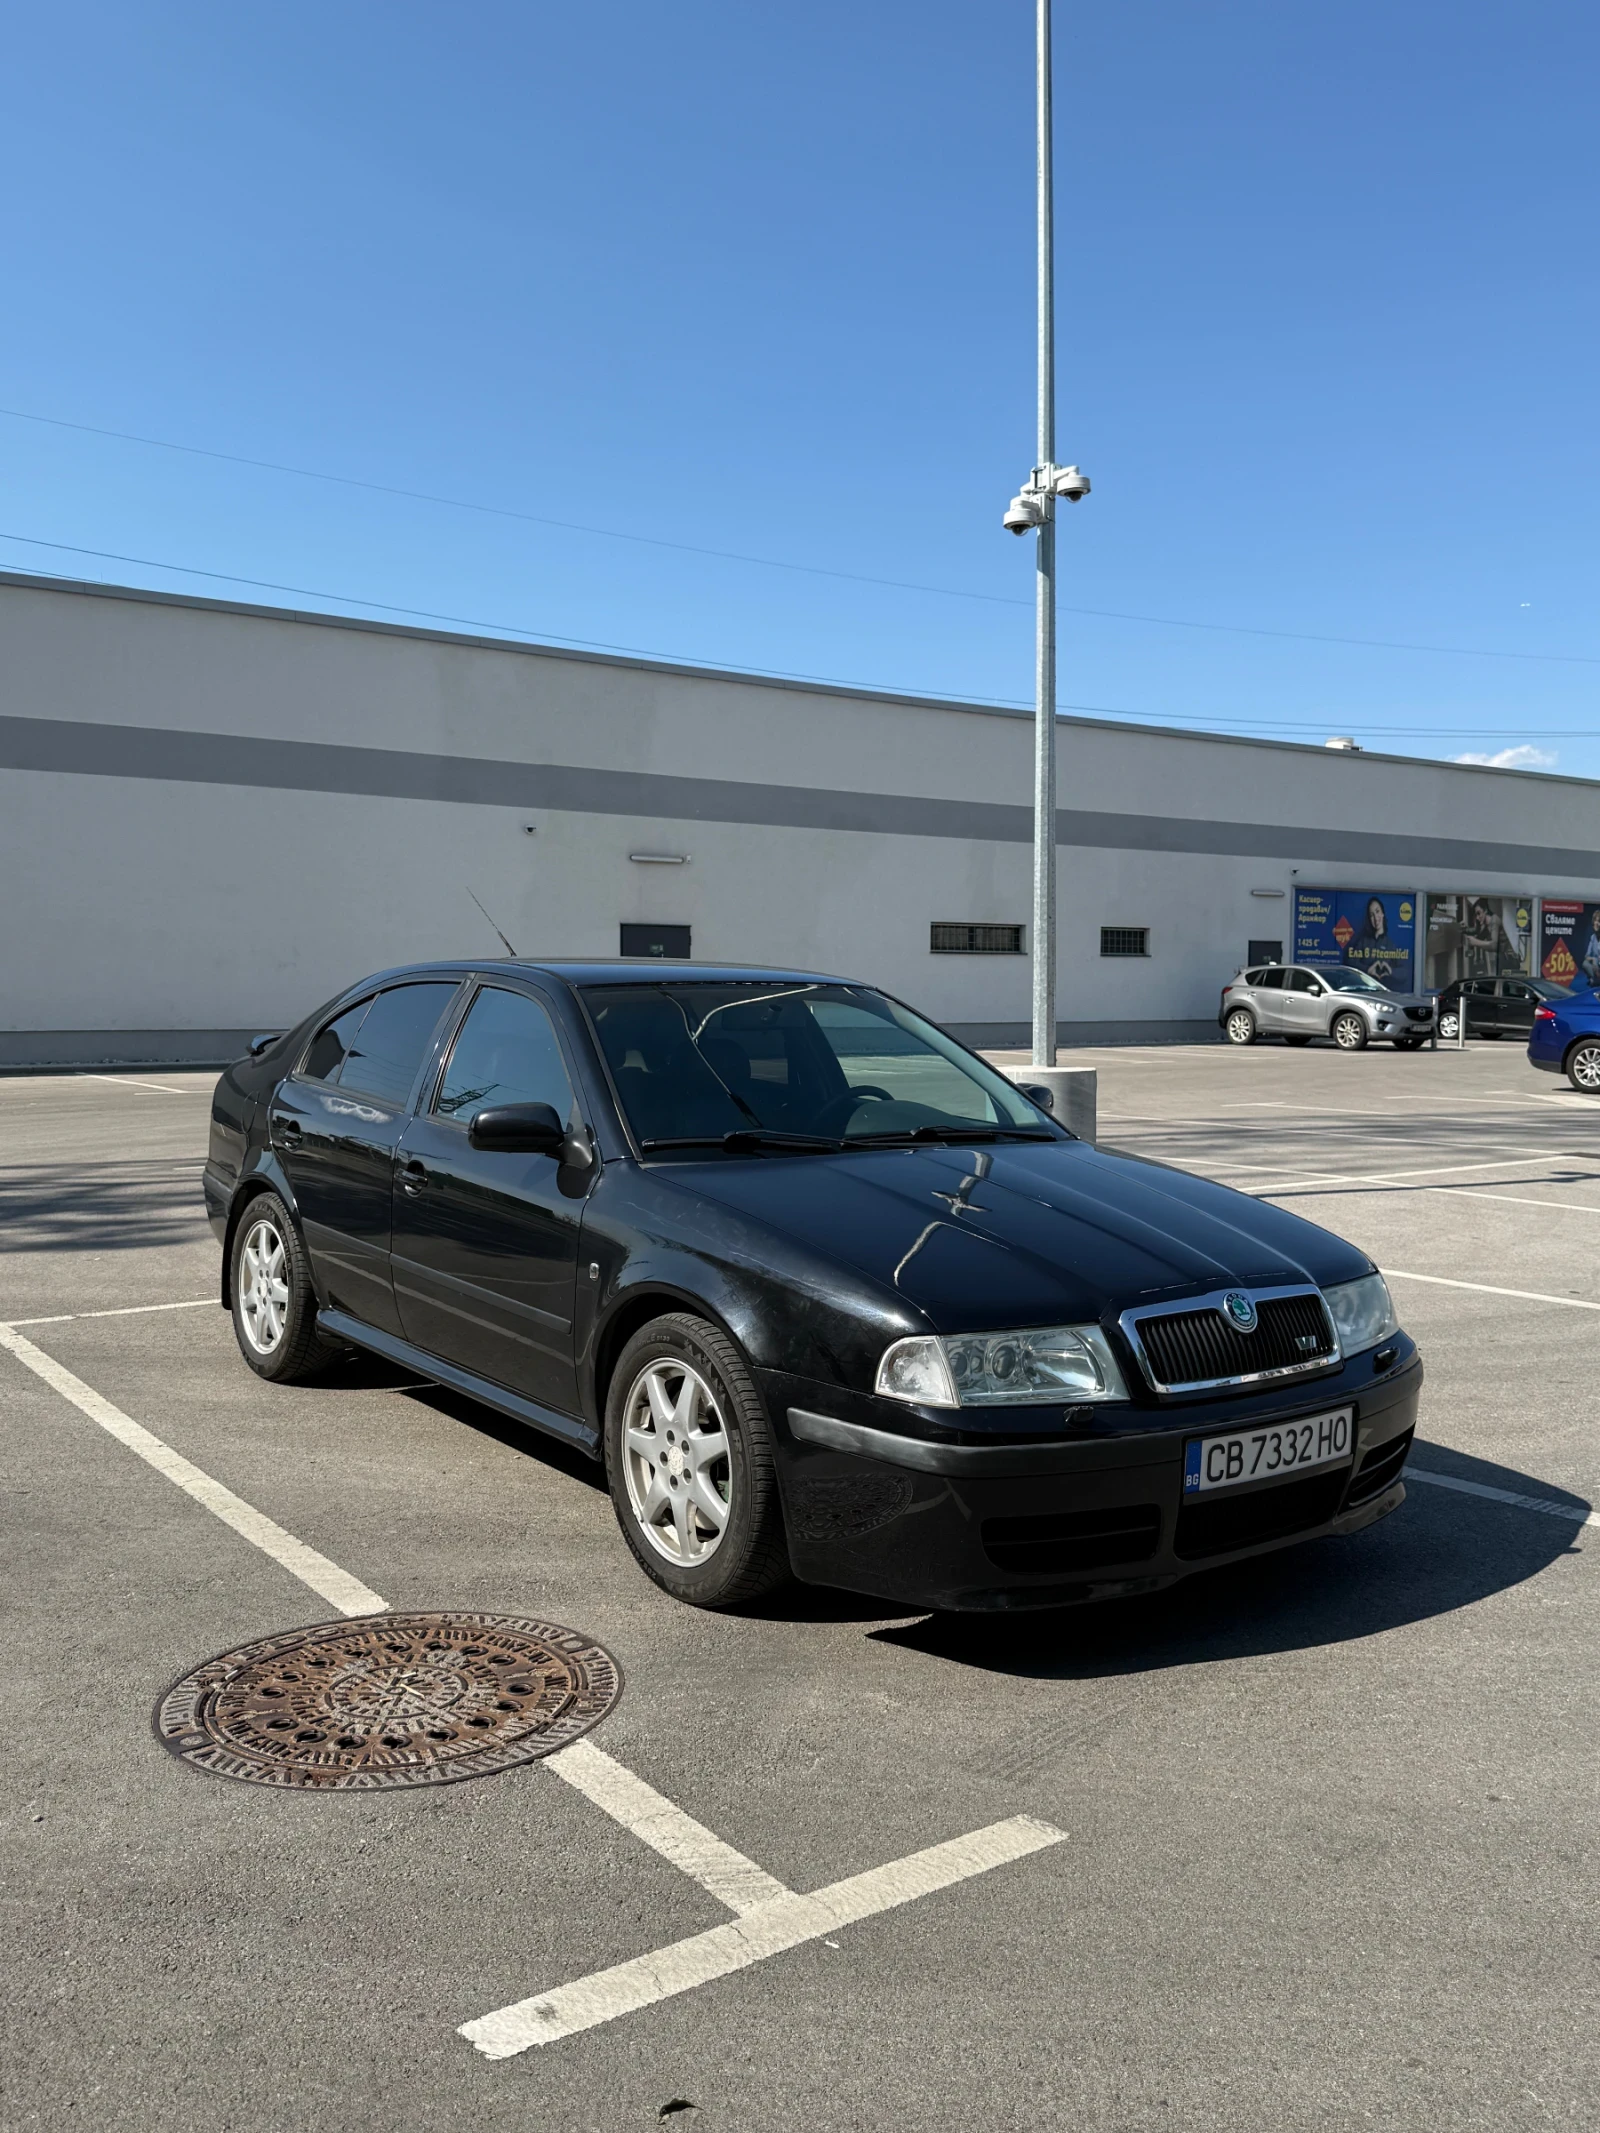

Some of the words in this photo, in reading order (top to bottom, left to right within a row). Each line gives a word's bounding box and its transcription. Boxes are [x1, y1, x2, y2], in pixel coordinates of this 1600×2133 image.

[1545, 914, 1576, 925] Сваляме
[1545, 926, 1573, 936] цените
[1348, 947, 1363, 958] Ела
[1545, 952, 1575, 974] -50%
[1206, 1440, 1244, 1483] CB
[1250, 1425, 1314, 1475] 7332
[1317, 1415, 1348, 1458] HO
[1185, 1474, 1200, 1487] BG
